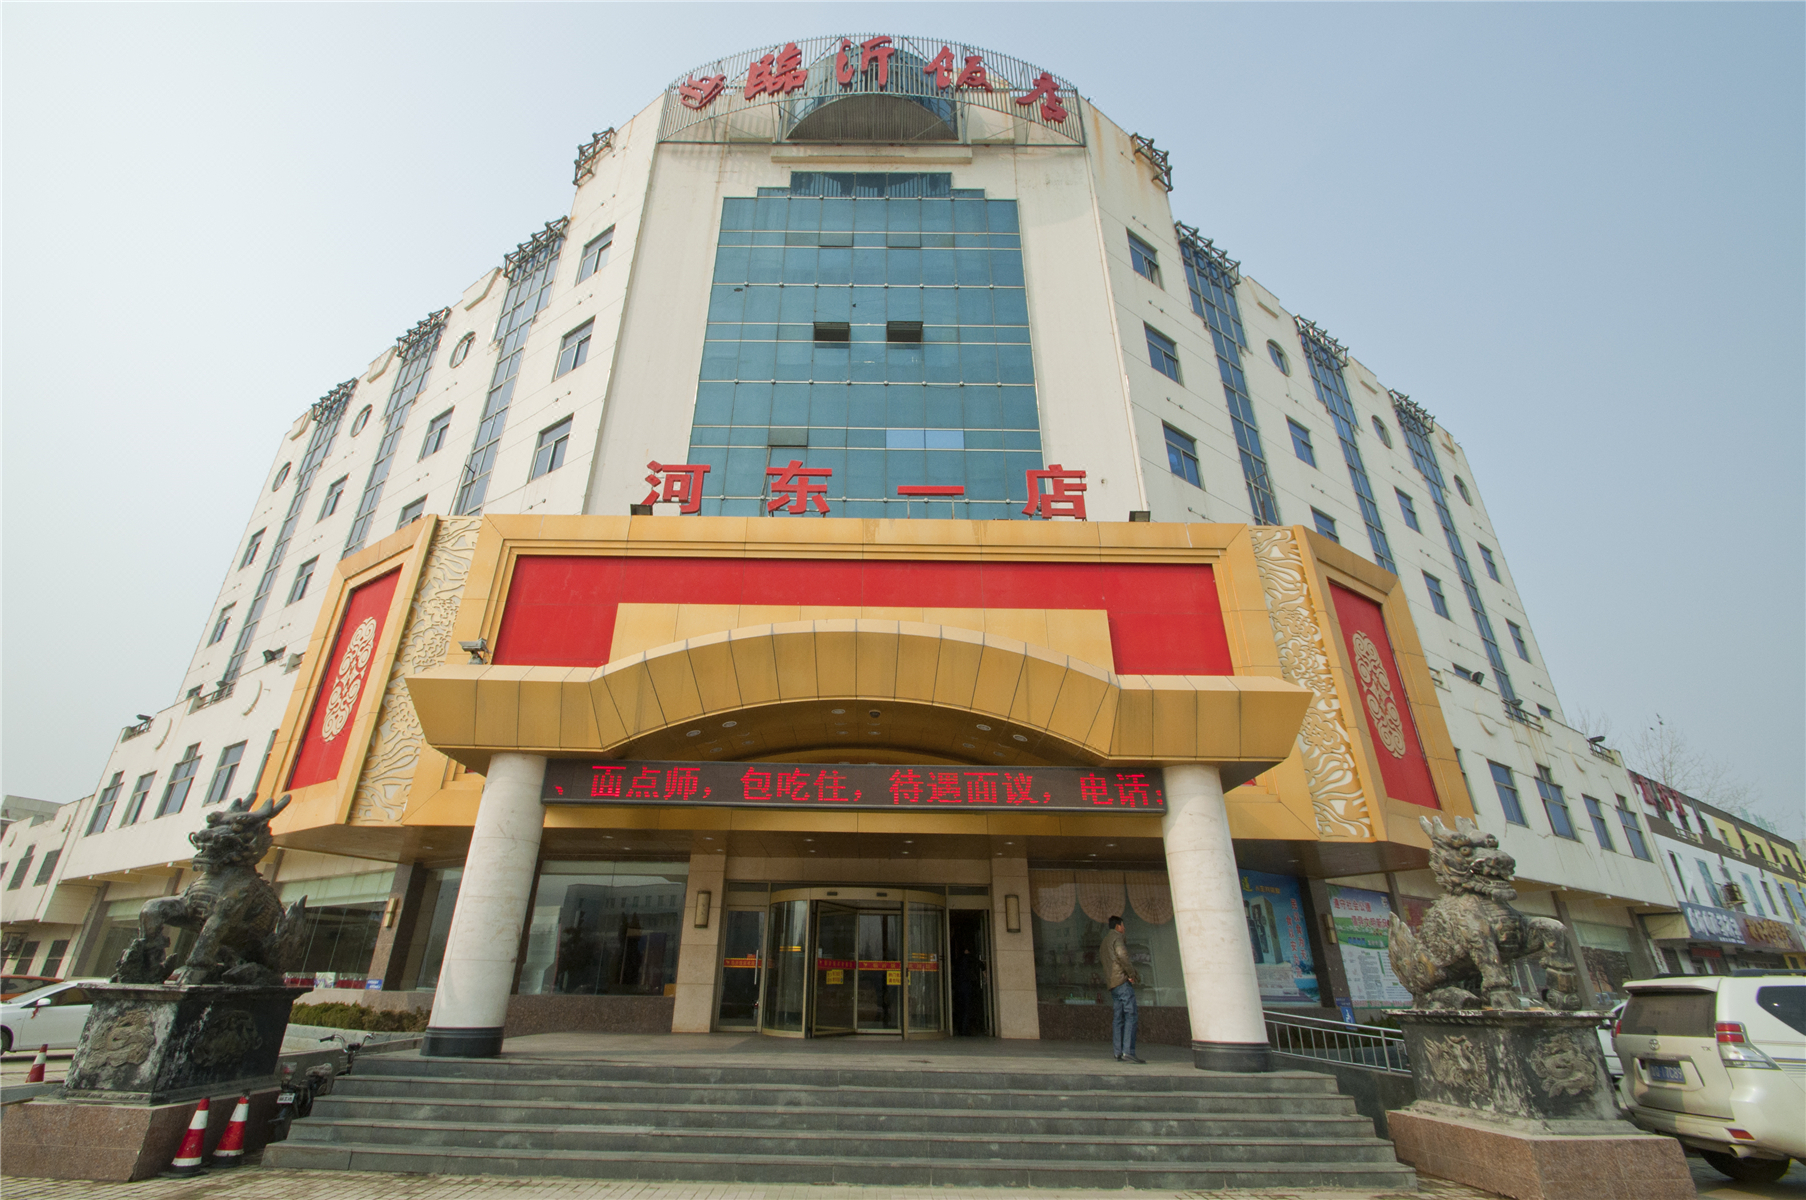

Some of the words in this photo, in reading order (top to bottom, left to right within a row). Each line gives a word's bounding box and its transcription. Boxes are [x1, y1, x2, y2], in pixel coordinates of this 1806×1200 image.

[641, 460, 1087, 520] 河东一店
[1290, 898, 1307, 960] 民以食为天
